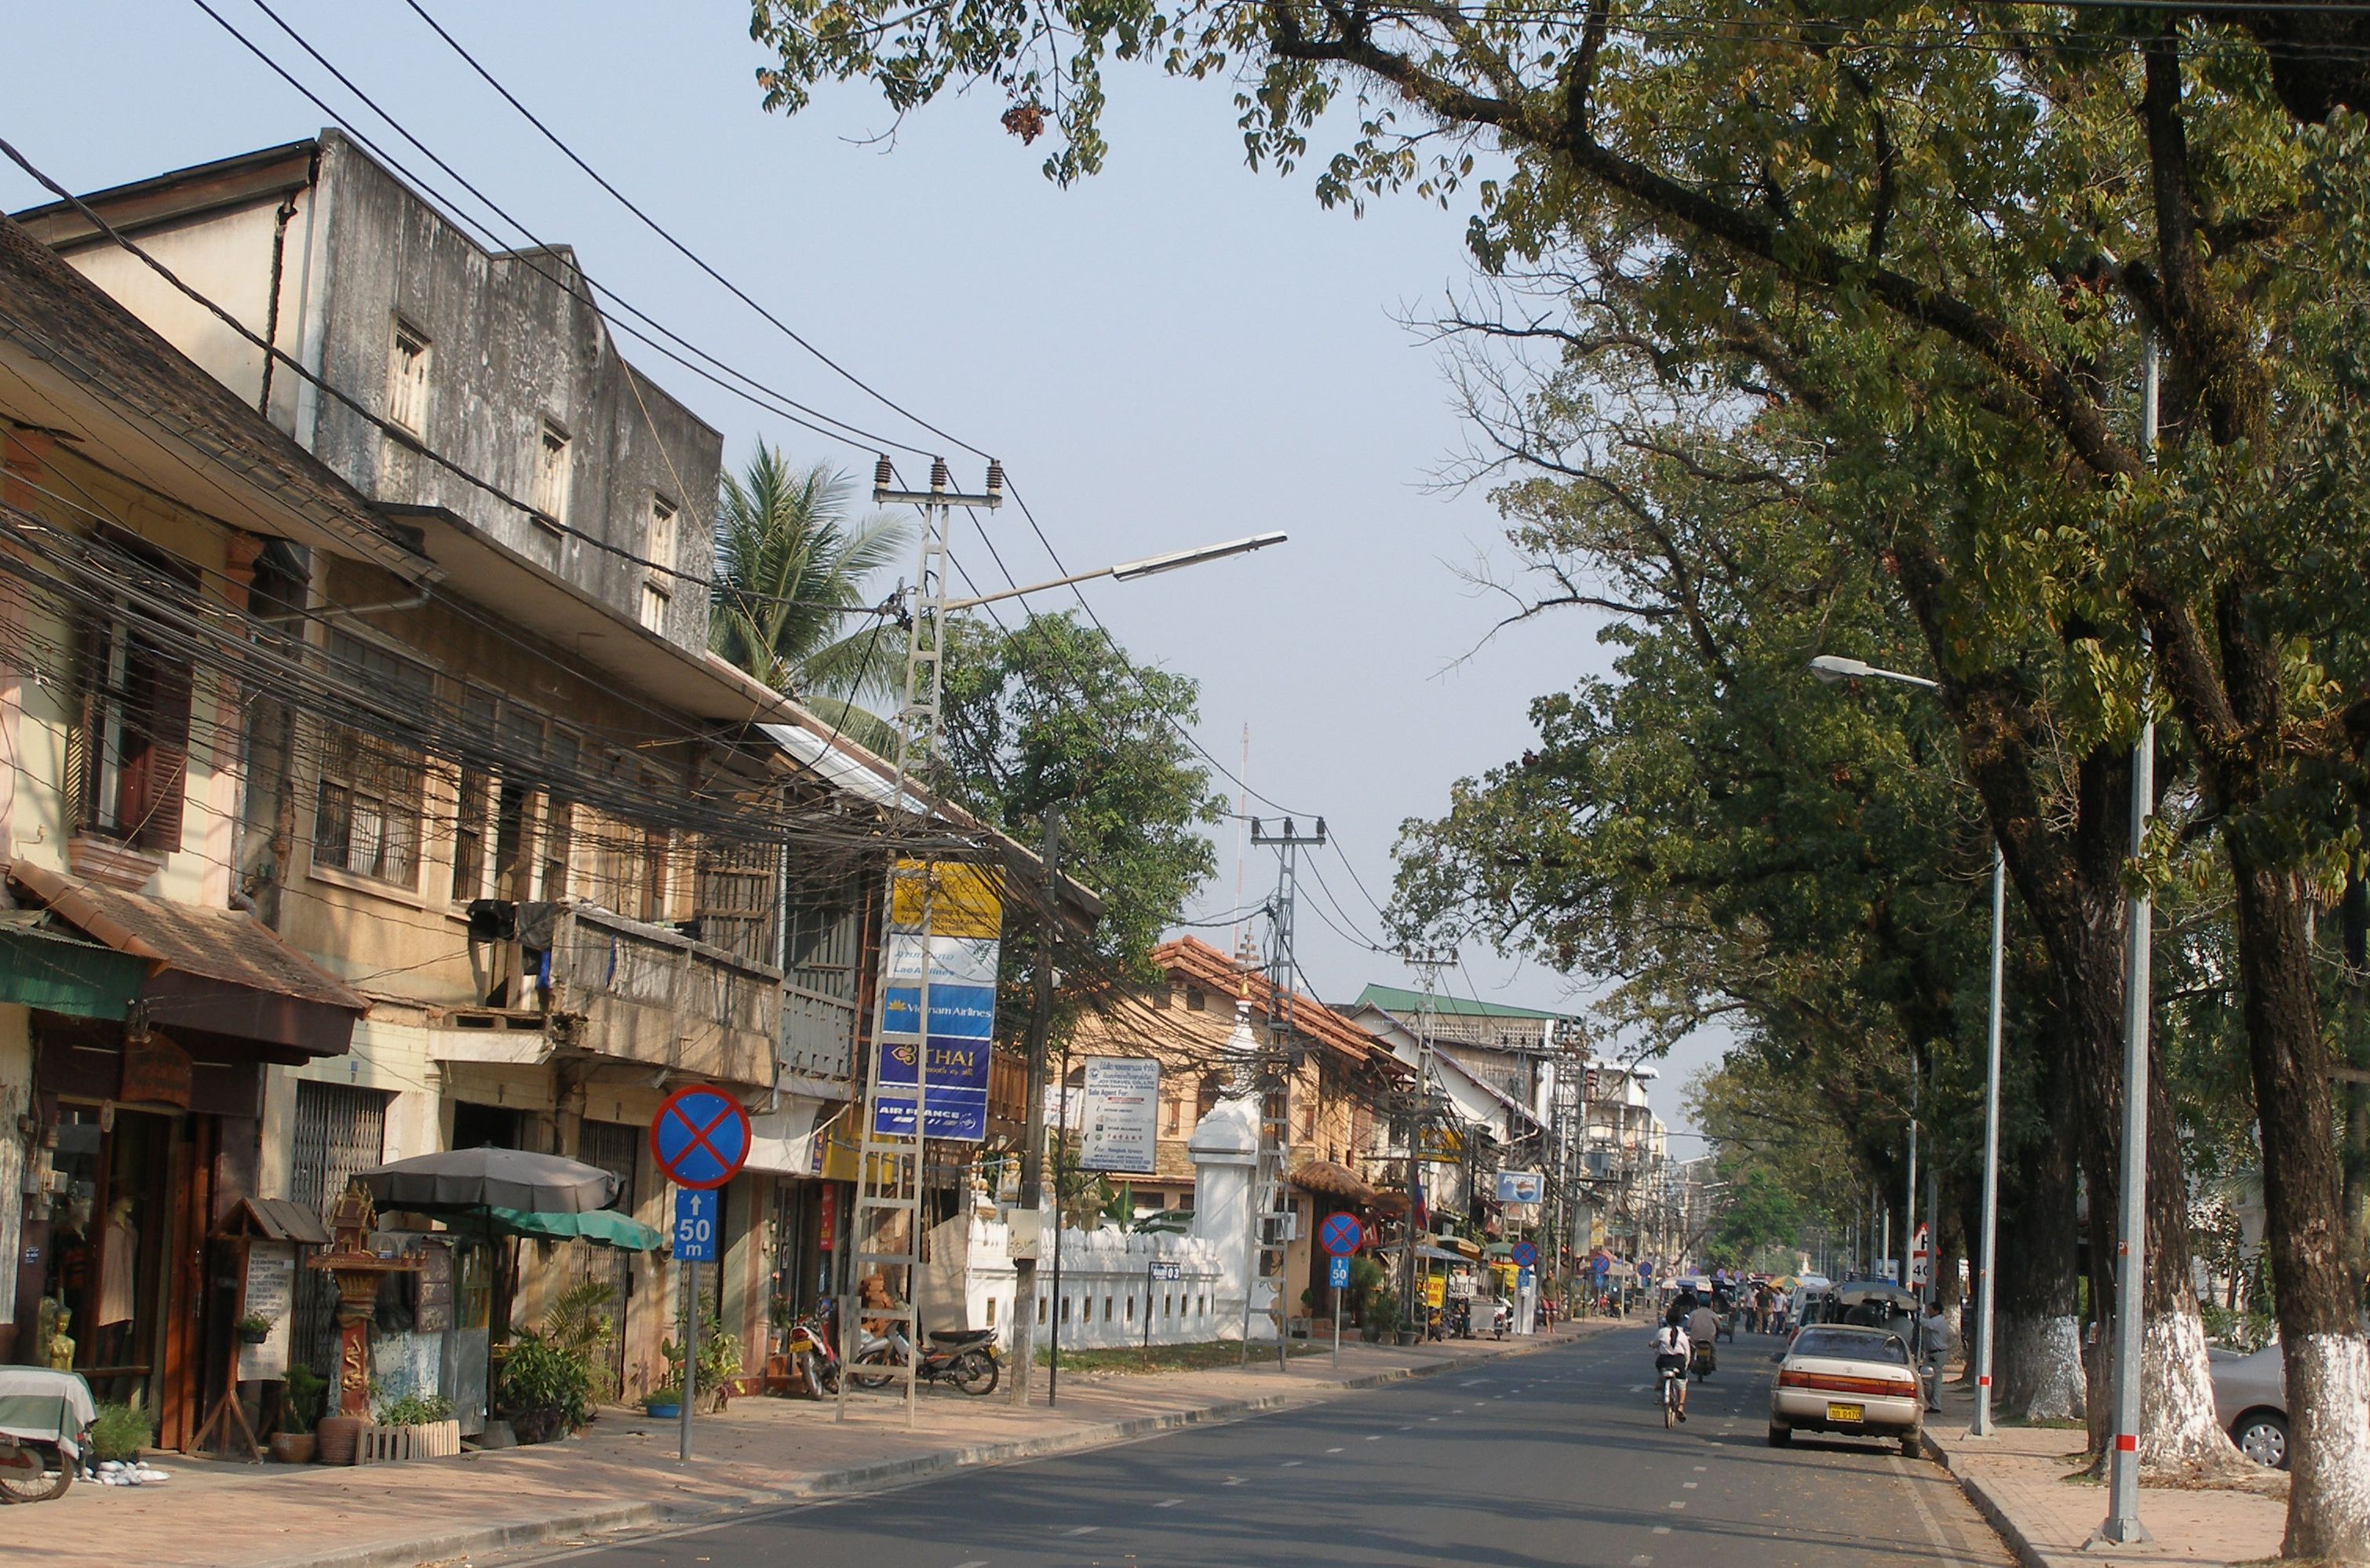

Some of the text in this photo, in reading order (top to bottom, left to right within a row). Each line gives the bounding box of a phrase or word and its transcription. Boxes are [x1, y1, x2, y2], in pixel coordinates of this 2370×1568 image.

[907, 1004, 992, 1018] Vienam Airlines
[879, 1107, 960, 1118] AIR FANCE
[1503, 1175, 1537, 1184] PEPSI
[680, 1219, 710, 1242] 50
[685, 1244, 702, 1256] m
[1333, 1269, 1347, 1280] 50
